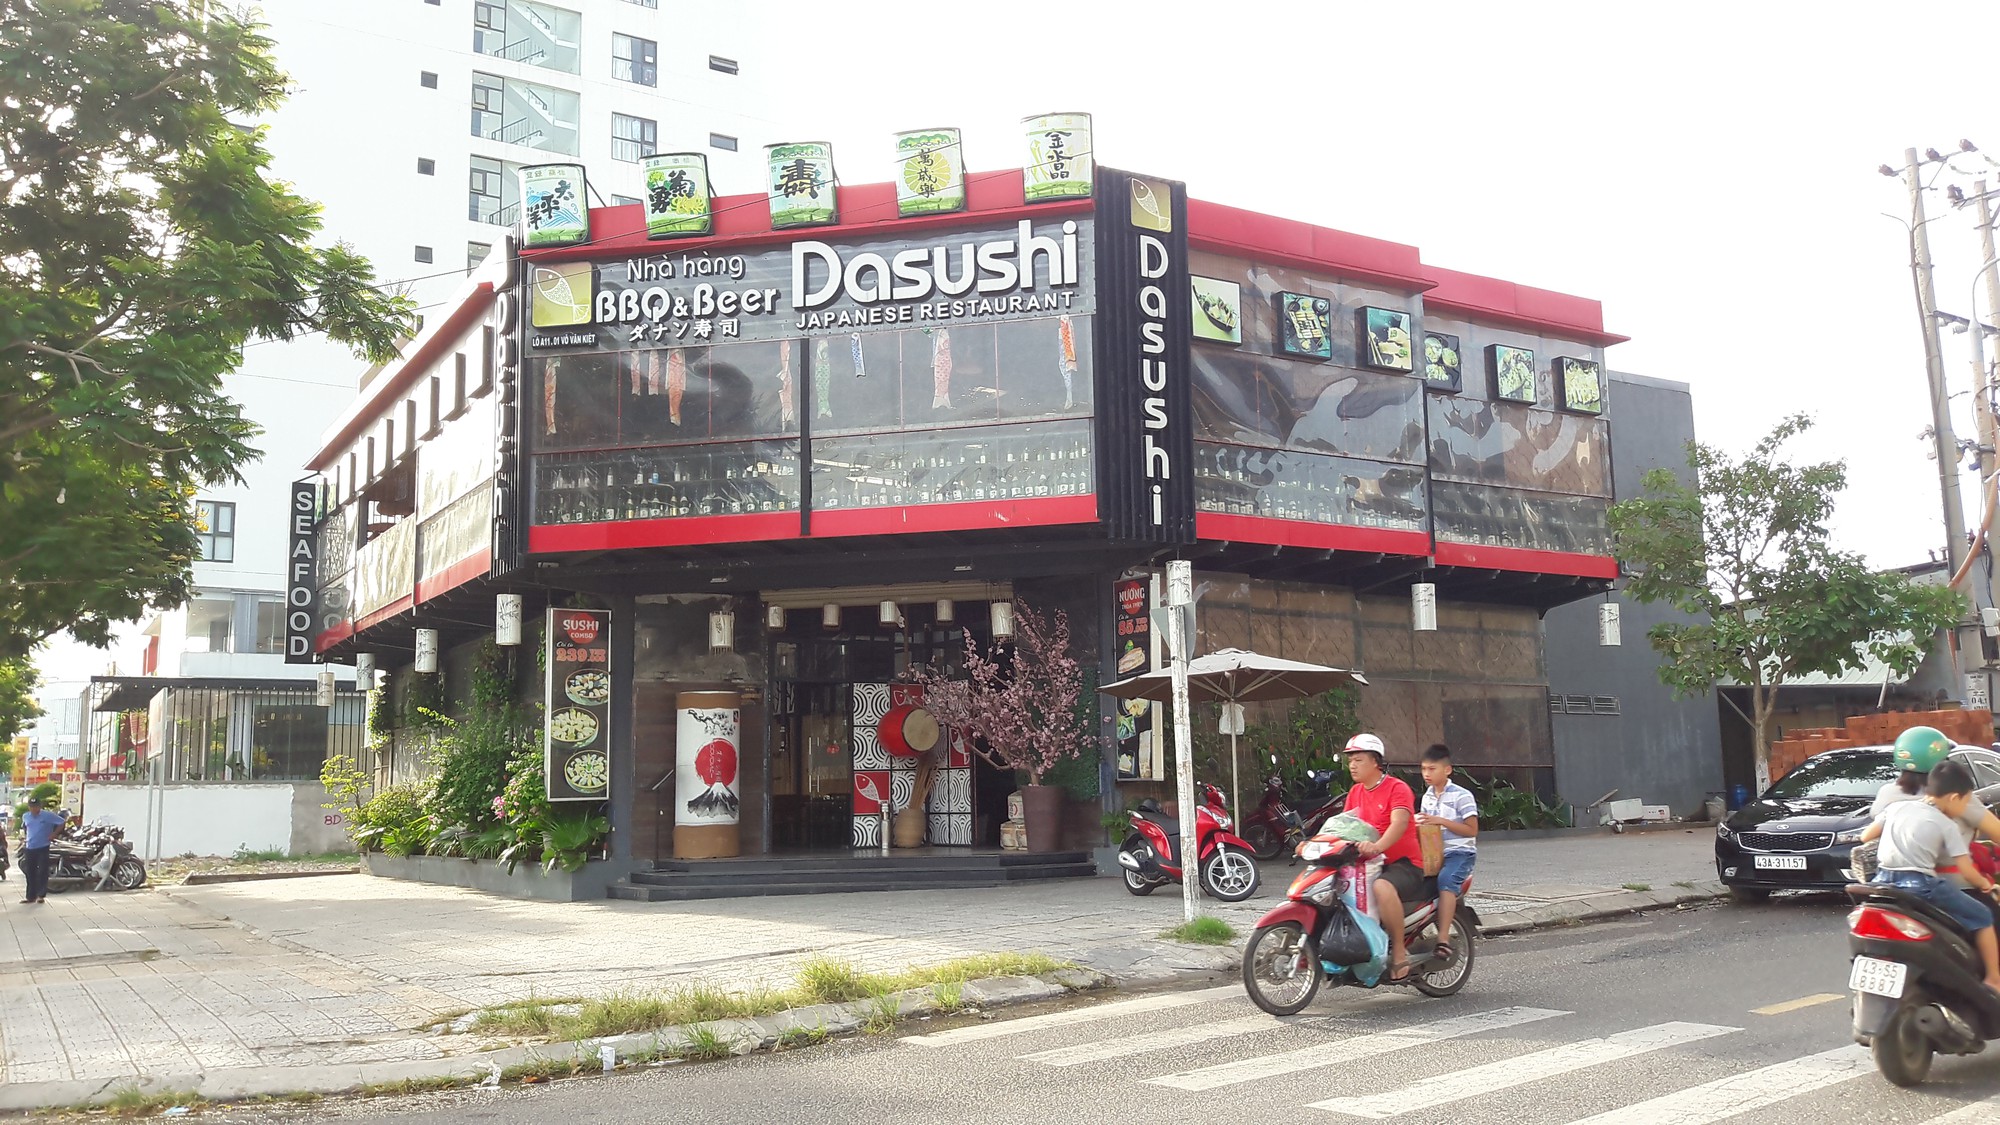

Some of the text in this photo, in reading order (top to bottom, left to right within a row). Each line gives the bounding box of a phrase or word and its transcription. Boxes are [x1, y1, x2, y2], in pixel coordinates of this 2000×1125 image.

[626, 251, 744, 281] Nhà hàng
[791, 219, 1078, 309] Dasushi
[795, 291, 1075, 330] JAPANESE RESTAURANT
[1138, 233, 1171, 526] Dasushi
[289, 491, 313, 657] SEAFOOD
[562, 619, 600, 632] SUSHI
[66, 774, 81, 782] SPA
[1756, 857, 1805, 868] 43A-311.57
